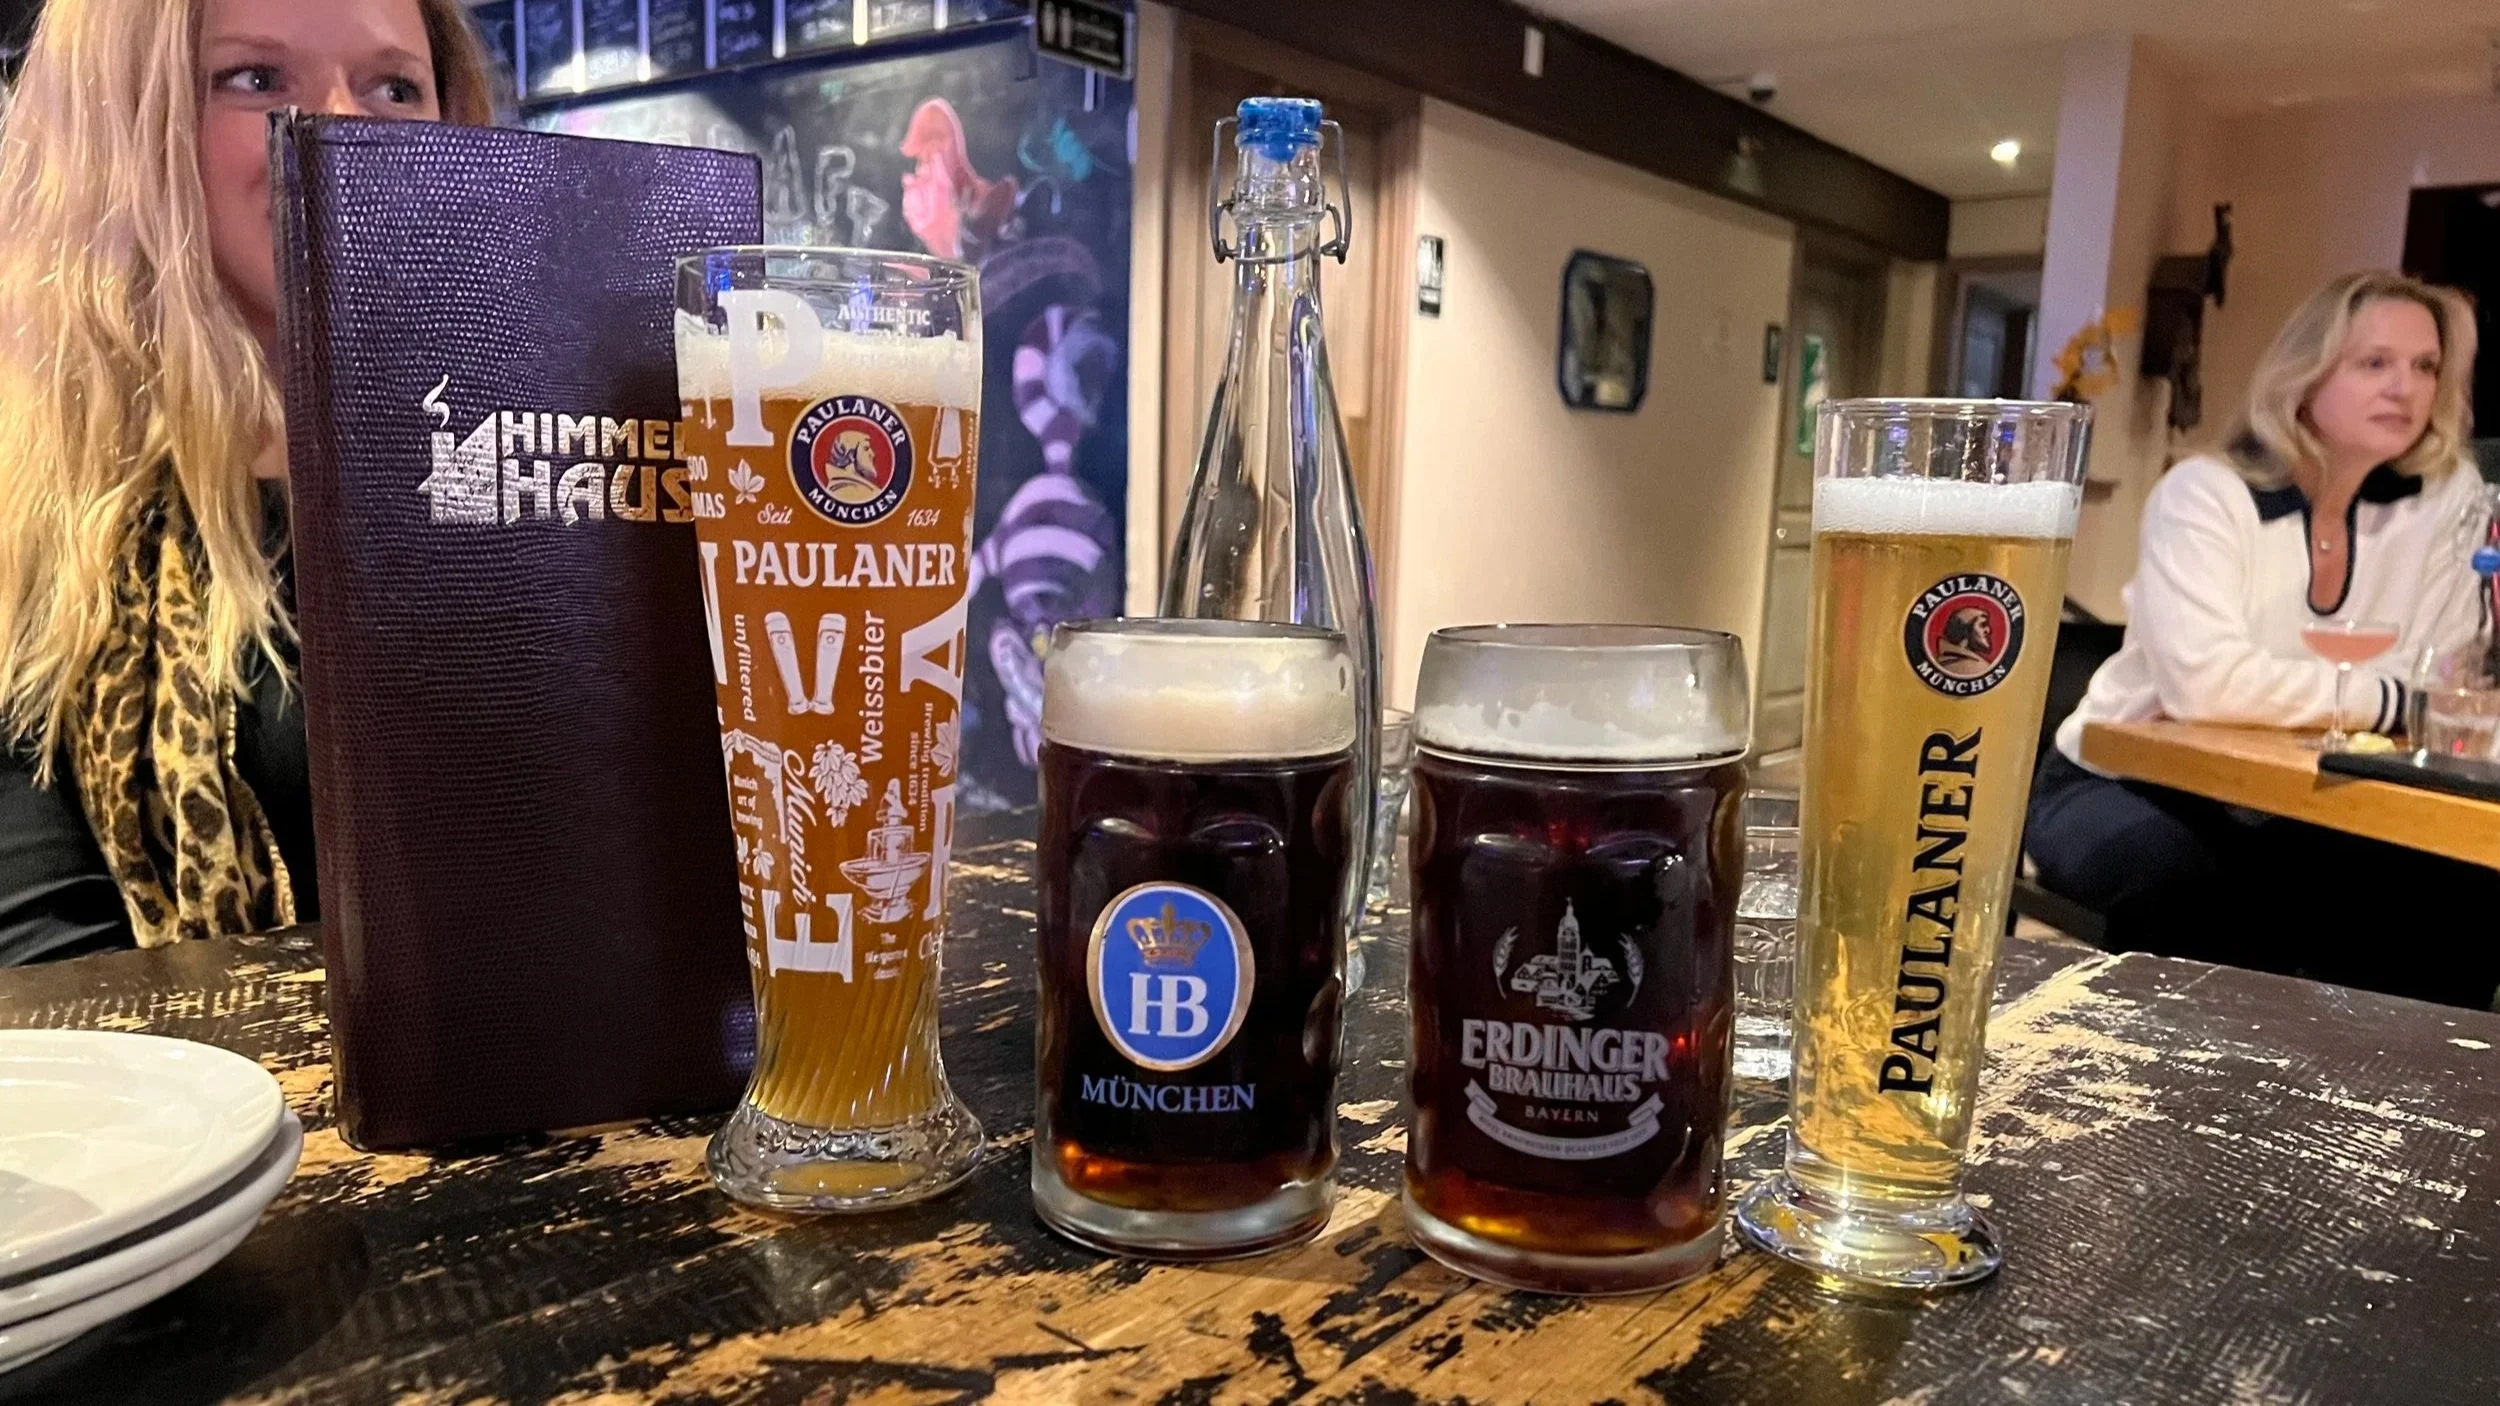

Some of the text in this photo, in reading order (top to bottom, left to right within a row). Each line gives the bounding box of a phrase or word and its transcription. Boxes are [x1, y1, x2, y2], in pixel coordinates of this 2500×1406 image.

[797, 398, 906, 446] PAULANER
[502, 456, 695, 525] HAUS
[907, 508, 941, 527] 1634
[732, 540, 956, 588] PAULANER
[1912, 576, 2022, 622] PAULANER
[733, 613, 757, 723] unfiltered
[858, 610, 887, 765] Weissbier
[910, 731, 920, 769] since
[919, 702, 934, 833] Brewing tradition
[1879, 727, 1982, 1096] PAULANER
[1128, 972, 1209, 1038] HB
[1460, 1018, 1672, 1082] ERDINGER
[1081, 1074, 1257, 1113] MÜNCHEN
[1488, 1063, 1643, 1103] BRAUHAUS
[1525, 1104, 1600, 1123] BAYERN
